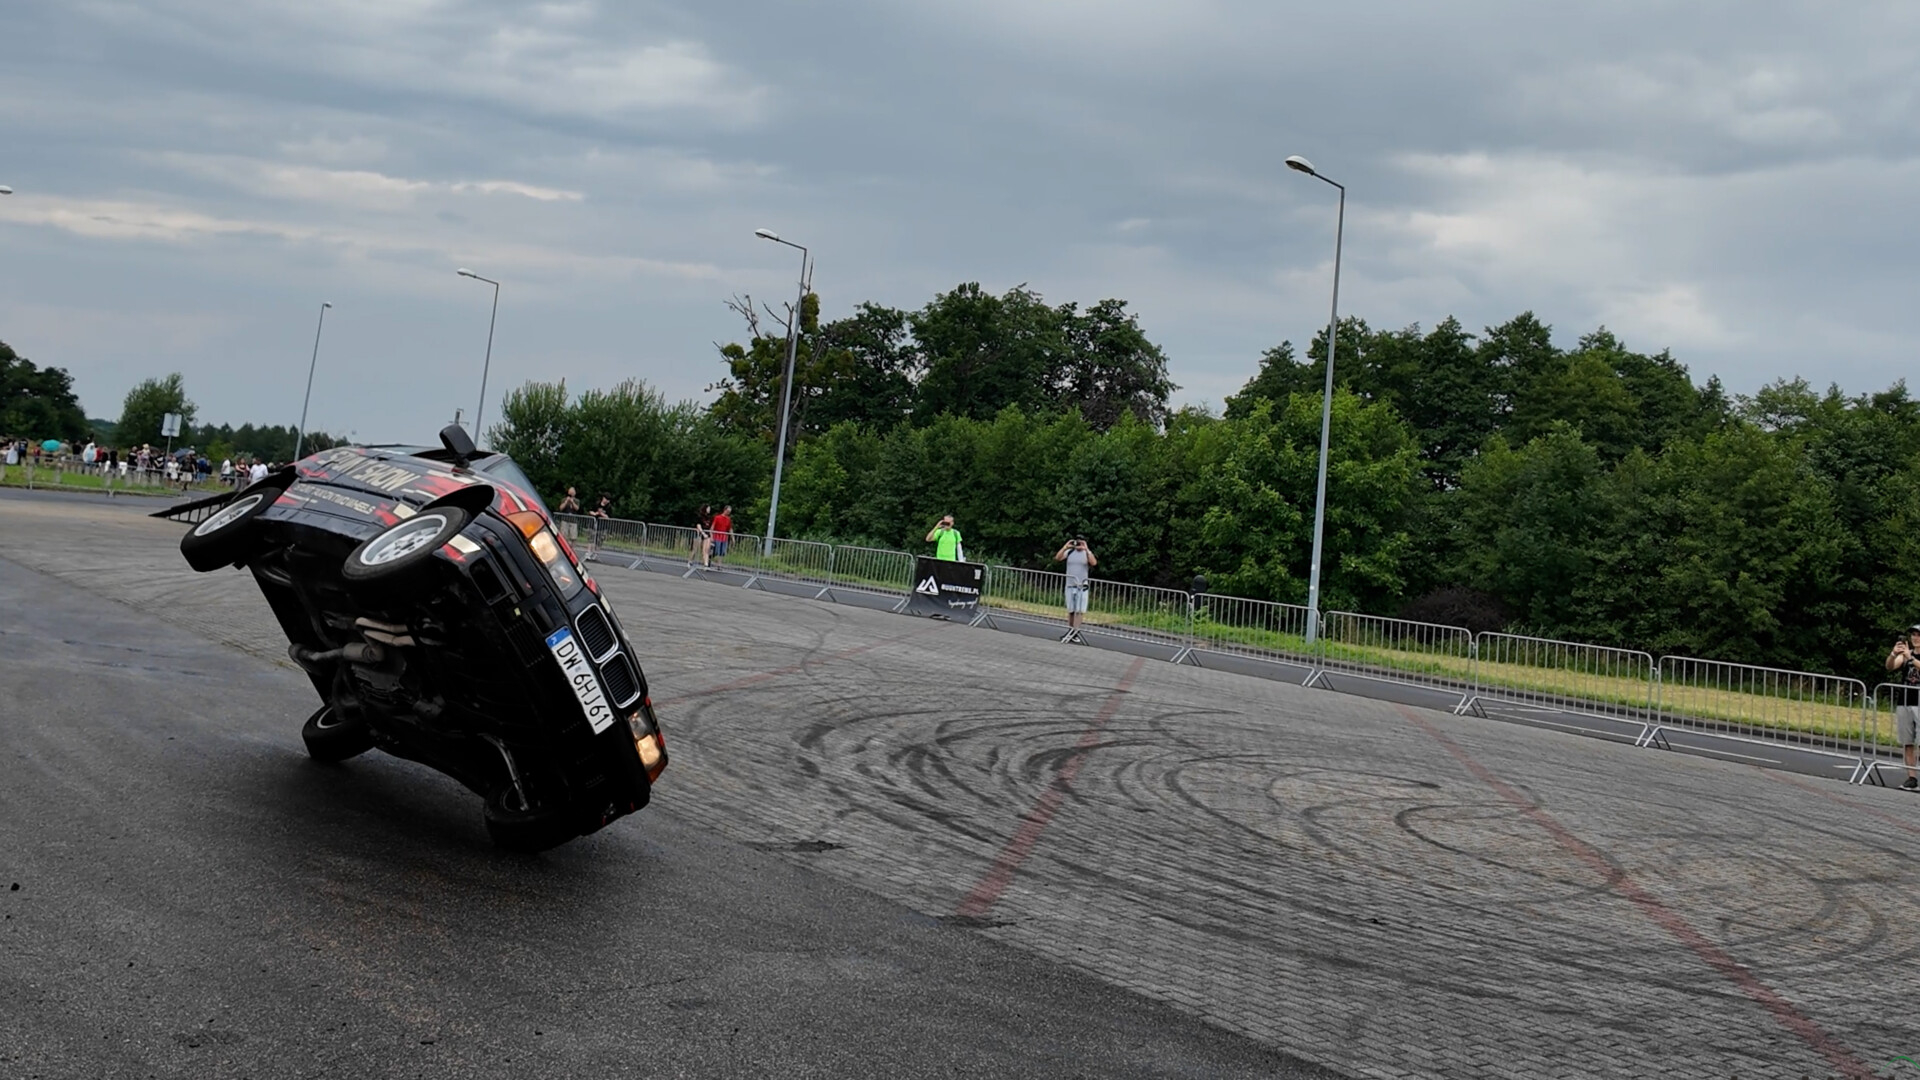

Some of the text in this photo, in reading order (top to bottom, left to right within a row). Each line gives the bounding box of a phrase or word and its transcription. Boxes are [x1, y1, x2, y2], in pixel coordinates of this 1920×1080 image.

[352, 463, 421, 491] SHOW
[345, 498, 376, 514] WHEELS
[556, 641, 610, 726] DW 6HJ61
